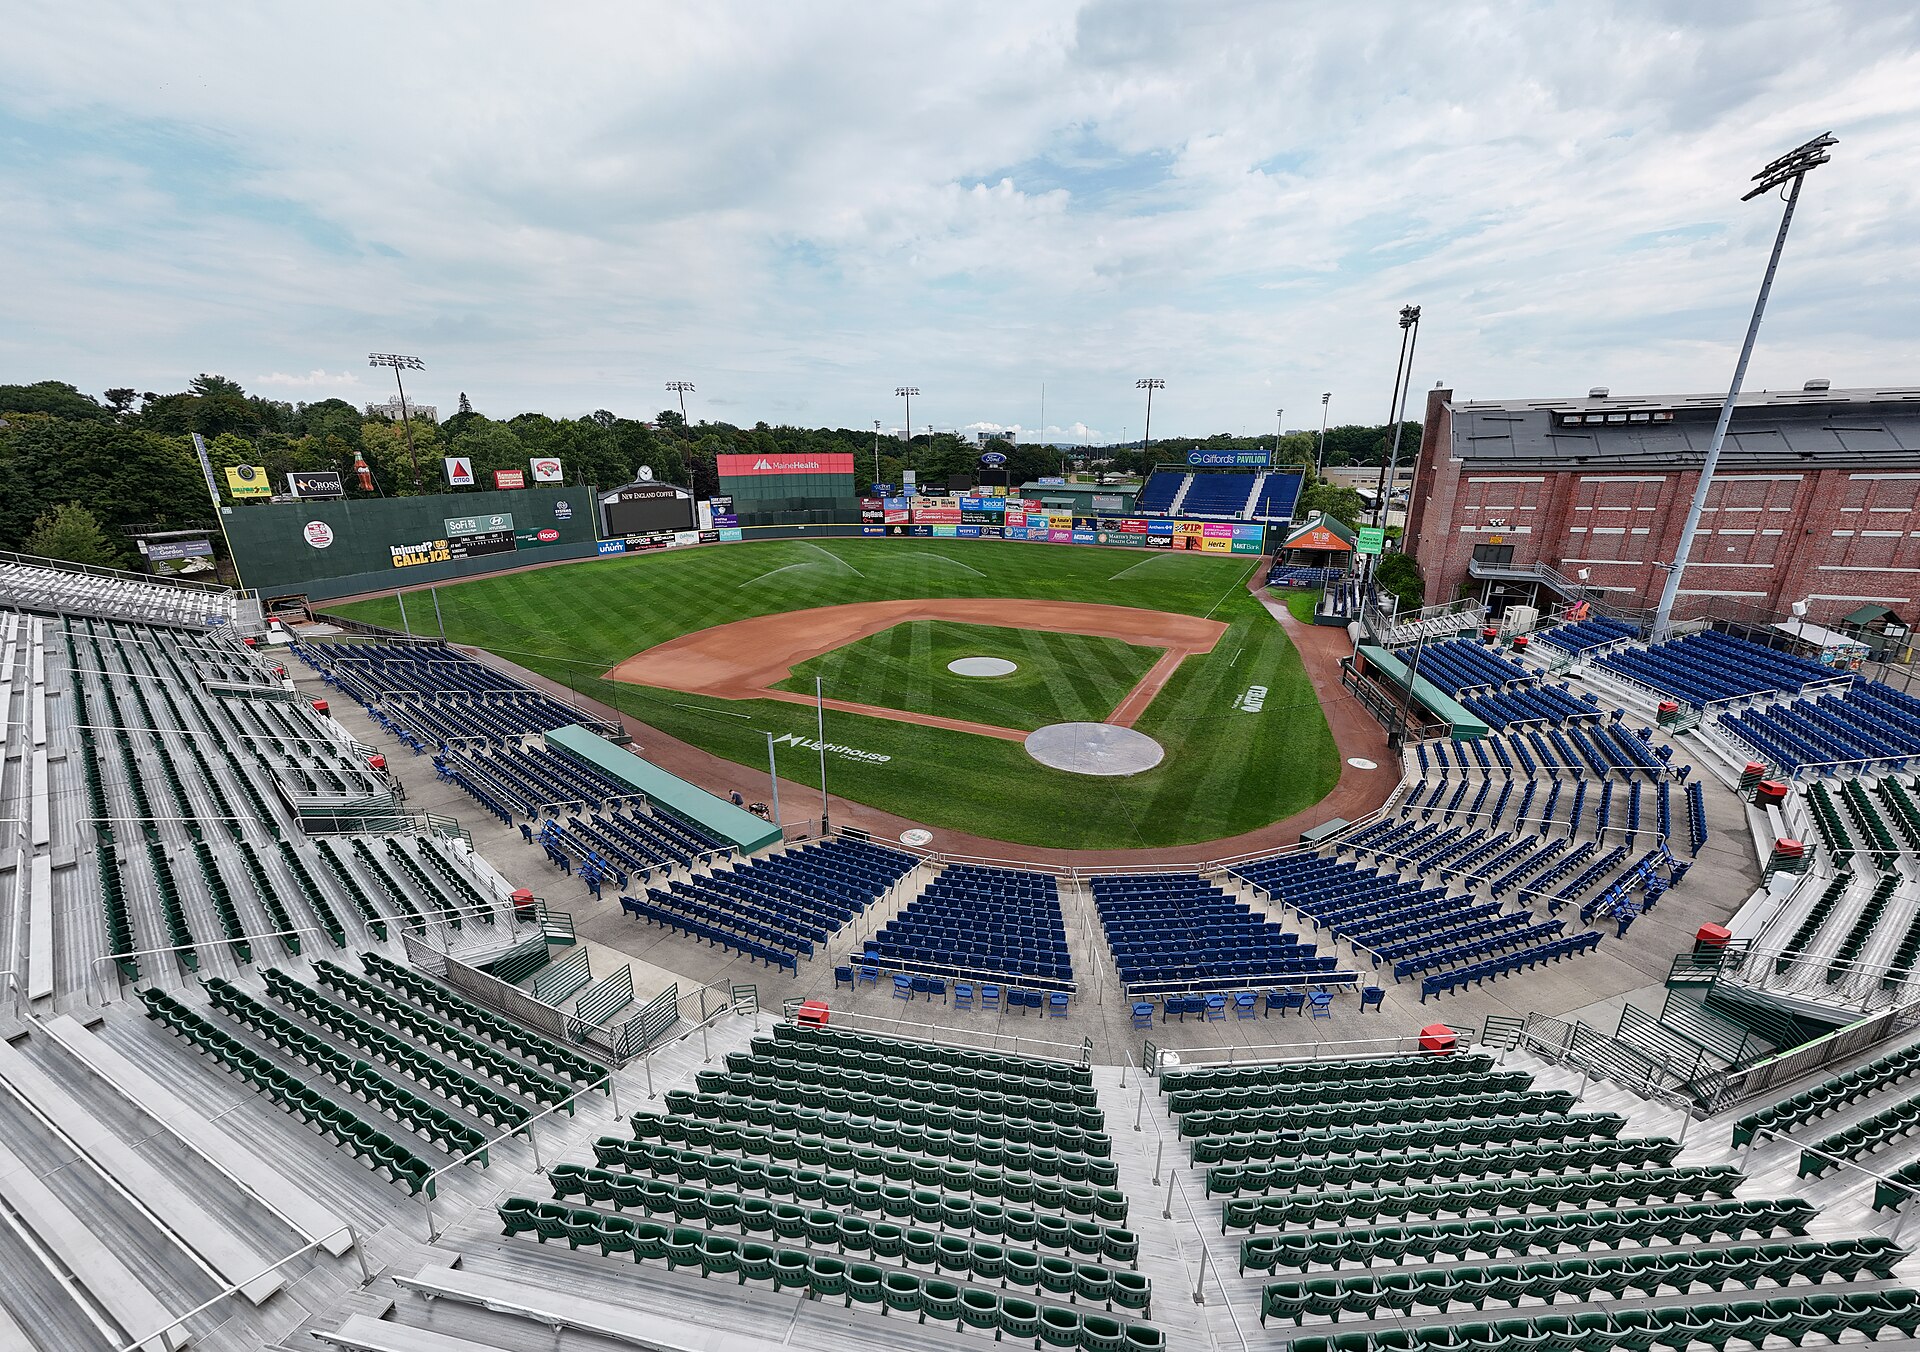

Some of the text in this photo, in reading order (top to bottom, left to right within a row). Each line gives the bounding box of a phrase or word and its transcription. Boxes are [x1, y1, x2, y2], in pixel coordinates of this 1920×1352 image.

[985, 455, 1001, 463] Ford
[1236, 455, 1267, 464] PAVILION
[773, 461, 819, 469] MaineHealth
[497, 471, 523, 480] Hammond
[621, 493, 633, 501] NEW
[634, 491, 656, 499] ENGLAND
[657, 490, 674, 498] COFFEE
[862, 510, 884, 519] KeyBank
[450, 520, 467, 531] SoFi
[1183, 523, 1202, 532] VIP
[1147, 536, 1171, 545] Geiger
[1208, 540, 1226, 548] Hertz
[390, 542, 433, 557] Injured?
[600, 541, 624, 553] unum
[800, 738, 892, 762] Lighthouse
[839, 754, 883, 765] Credit Union
